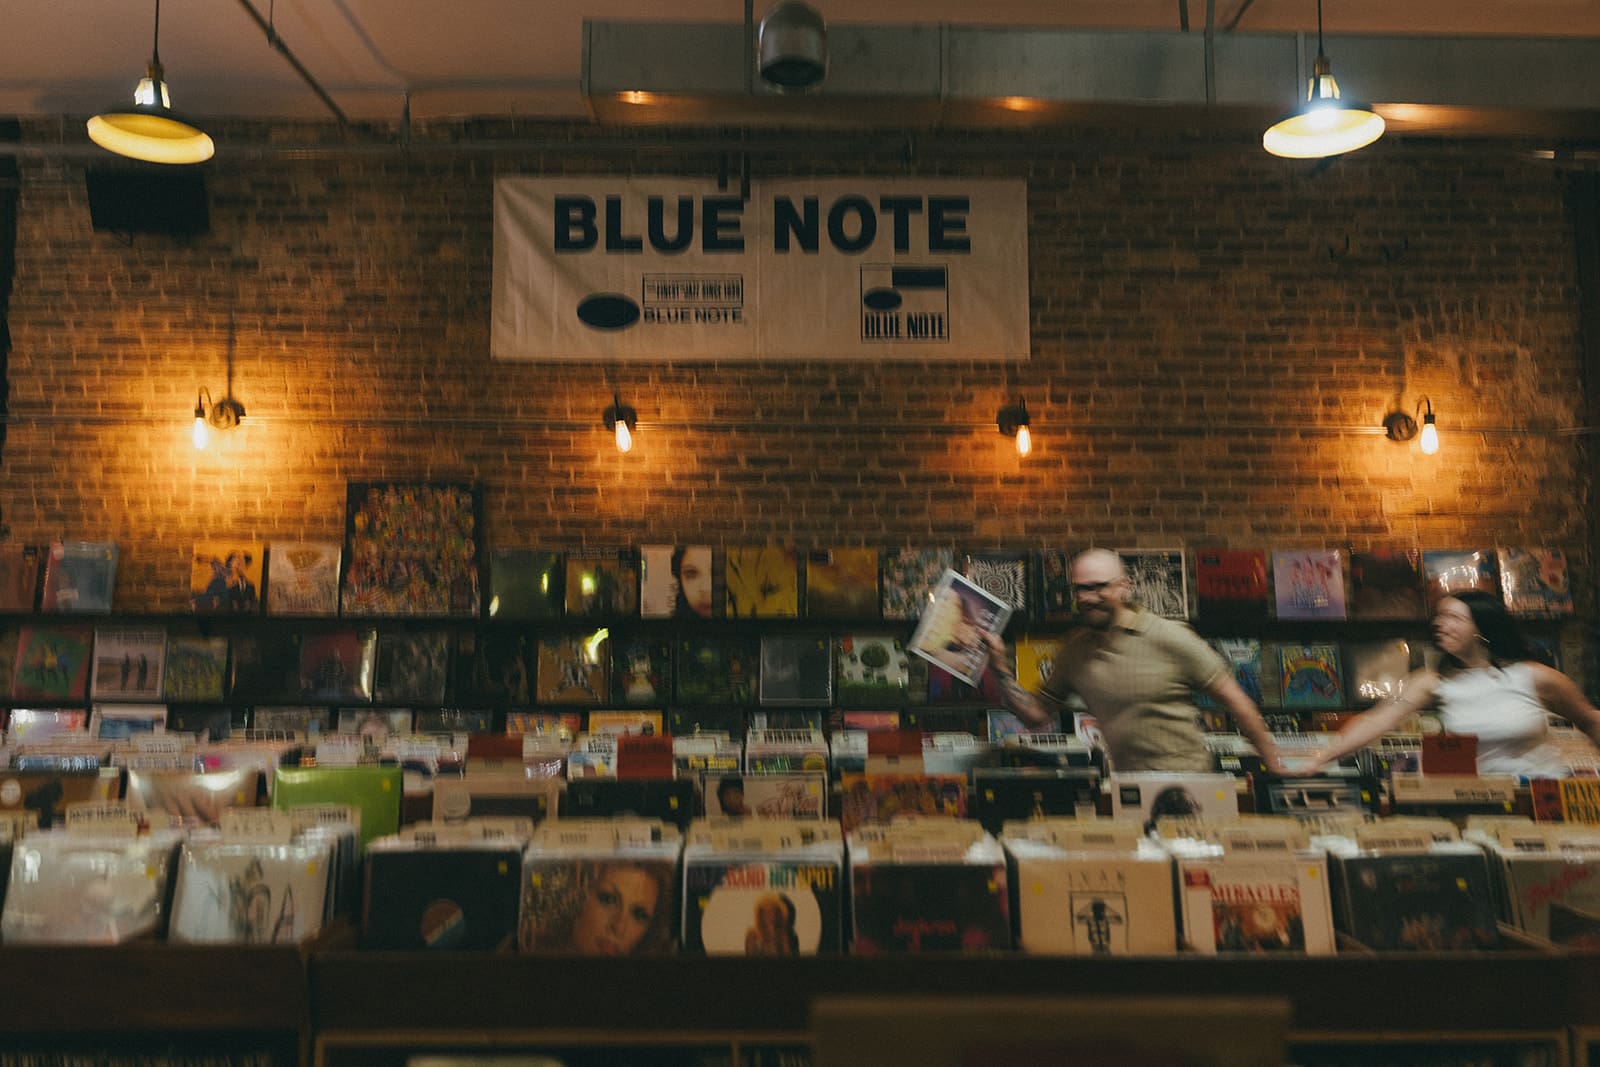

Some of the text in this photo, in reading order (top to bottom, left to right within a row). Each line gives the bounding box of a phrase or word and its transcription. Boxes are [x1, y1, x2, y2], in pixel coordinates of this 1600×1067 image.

[553, 194, 971, 255] BLUE NOTE
[643, 307, 743, 324] BLUE NOTE
[864, 312, 946, 340] BLUE NOTE
[1210, 884, 1300, 903] MIRACLES
